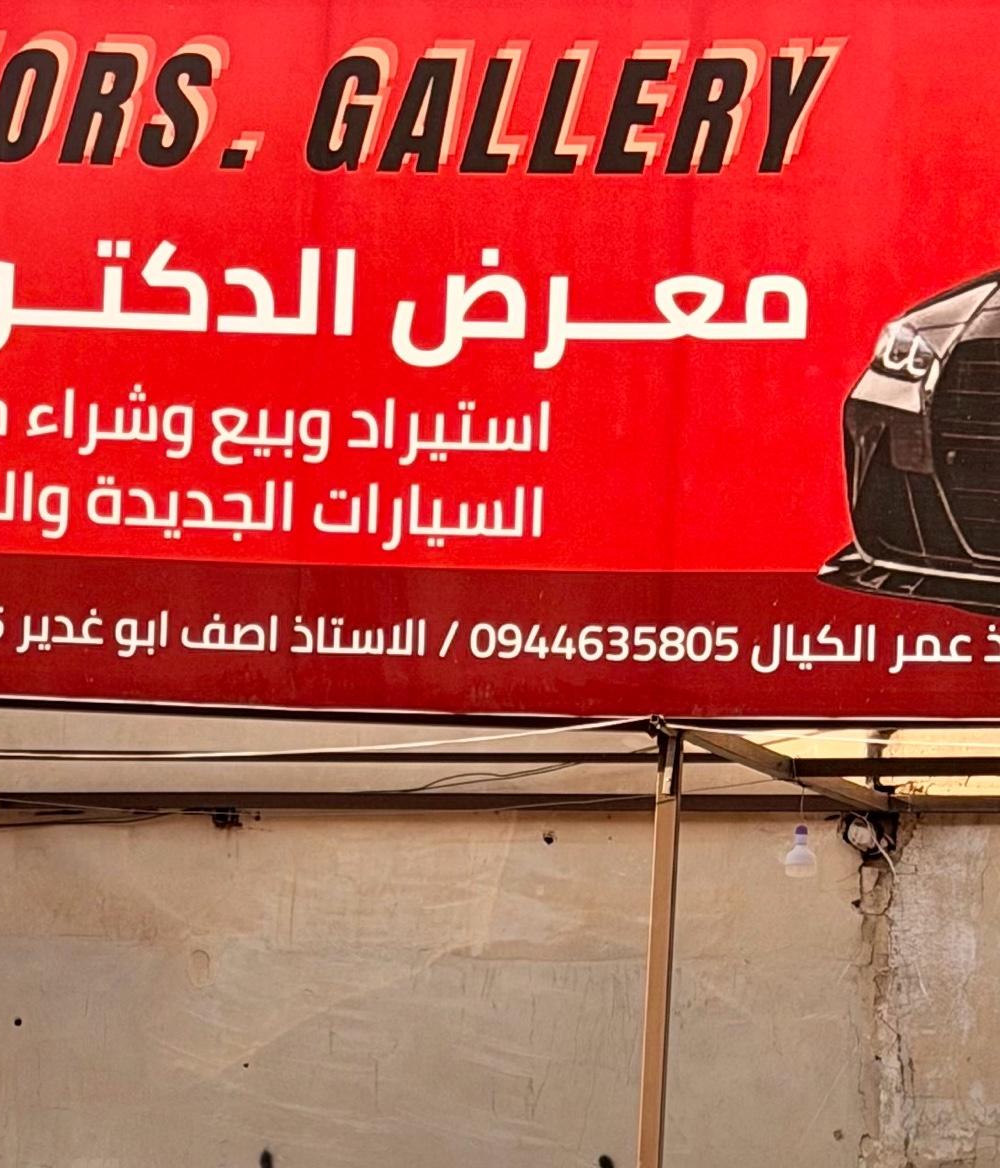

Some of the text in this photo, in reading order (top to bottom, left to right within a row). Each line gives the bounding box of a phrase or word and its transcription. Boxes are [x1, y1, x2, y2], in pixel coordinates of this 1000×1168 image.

[305, 38, 846, 175] GALLERY
[391, 247, 808, 370] معرض
[26, 383, 194, 459] وشراء
[211, 407, 331, 466] وبيع
[347, 397, 550, 466] استيراد
[86, 475, 293, 542] الجديدة
[313, 482, 543, 551] السيارات
[15, 608, 104, 653] غدير
[115, 610, 168, 658] ابو
[181, 613, 278, 652] اصف
[290, 615, 426, 657] الاستاذ
[439, 620, 459, 658] /
[470, 622, 739, 662] 0944635805
[751, 623, 876, 674] الكيال
[888, 634, 973, 674] عمر
